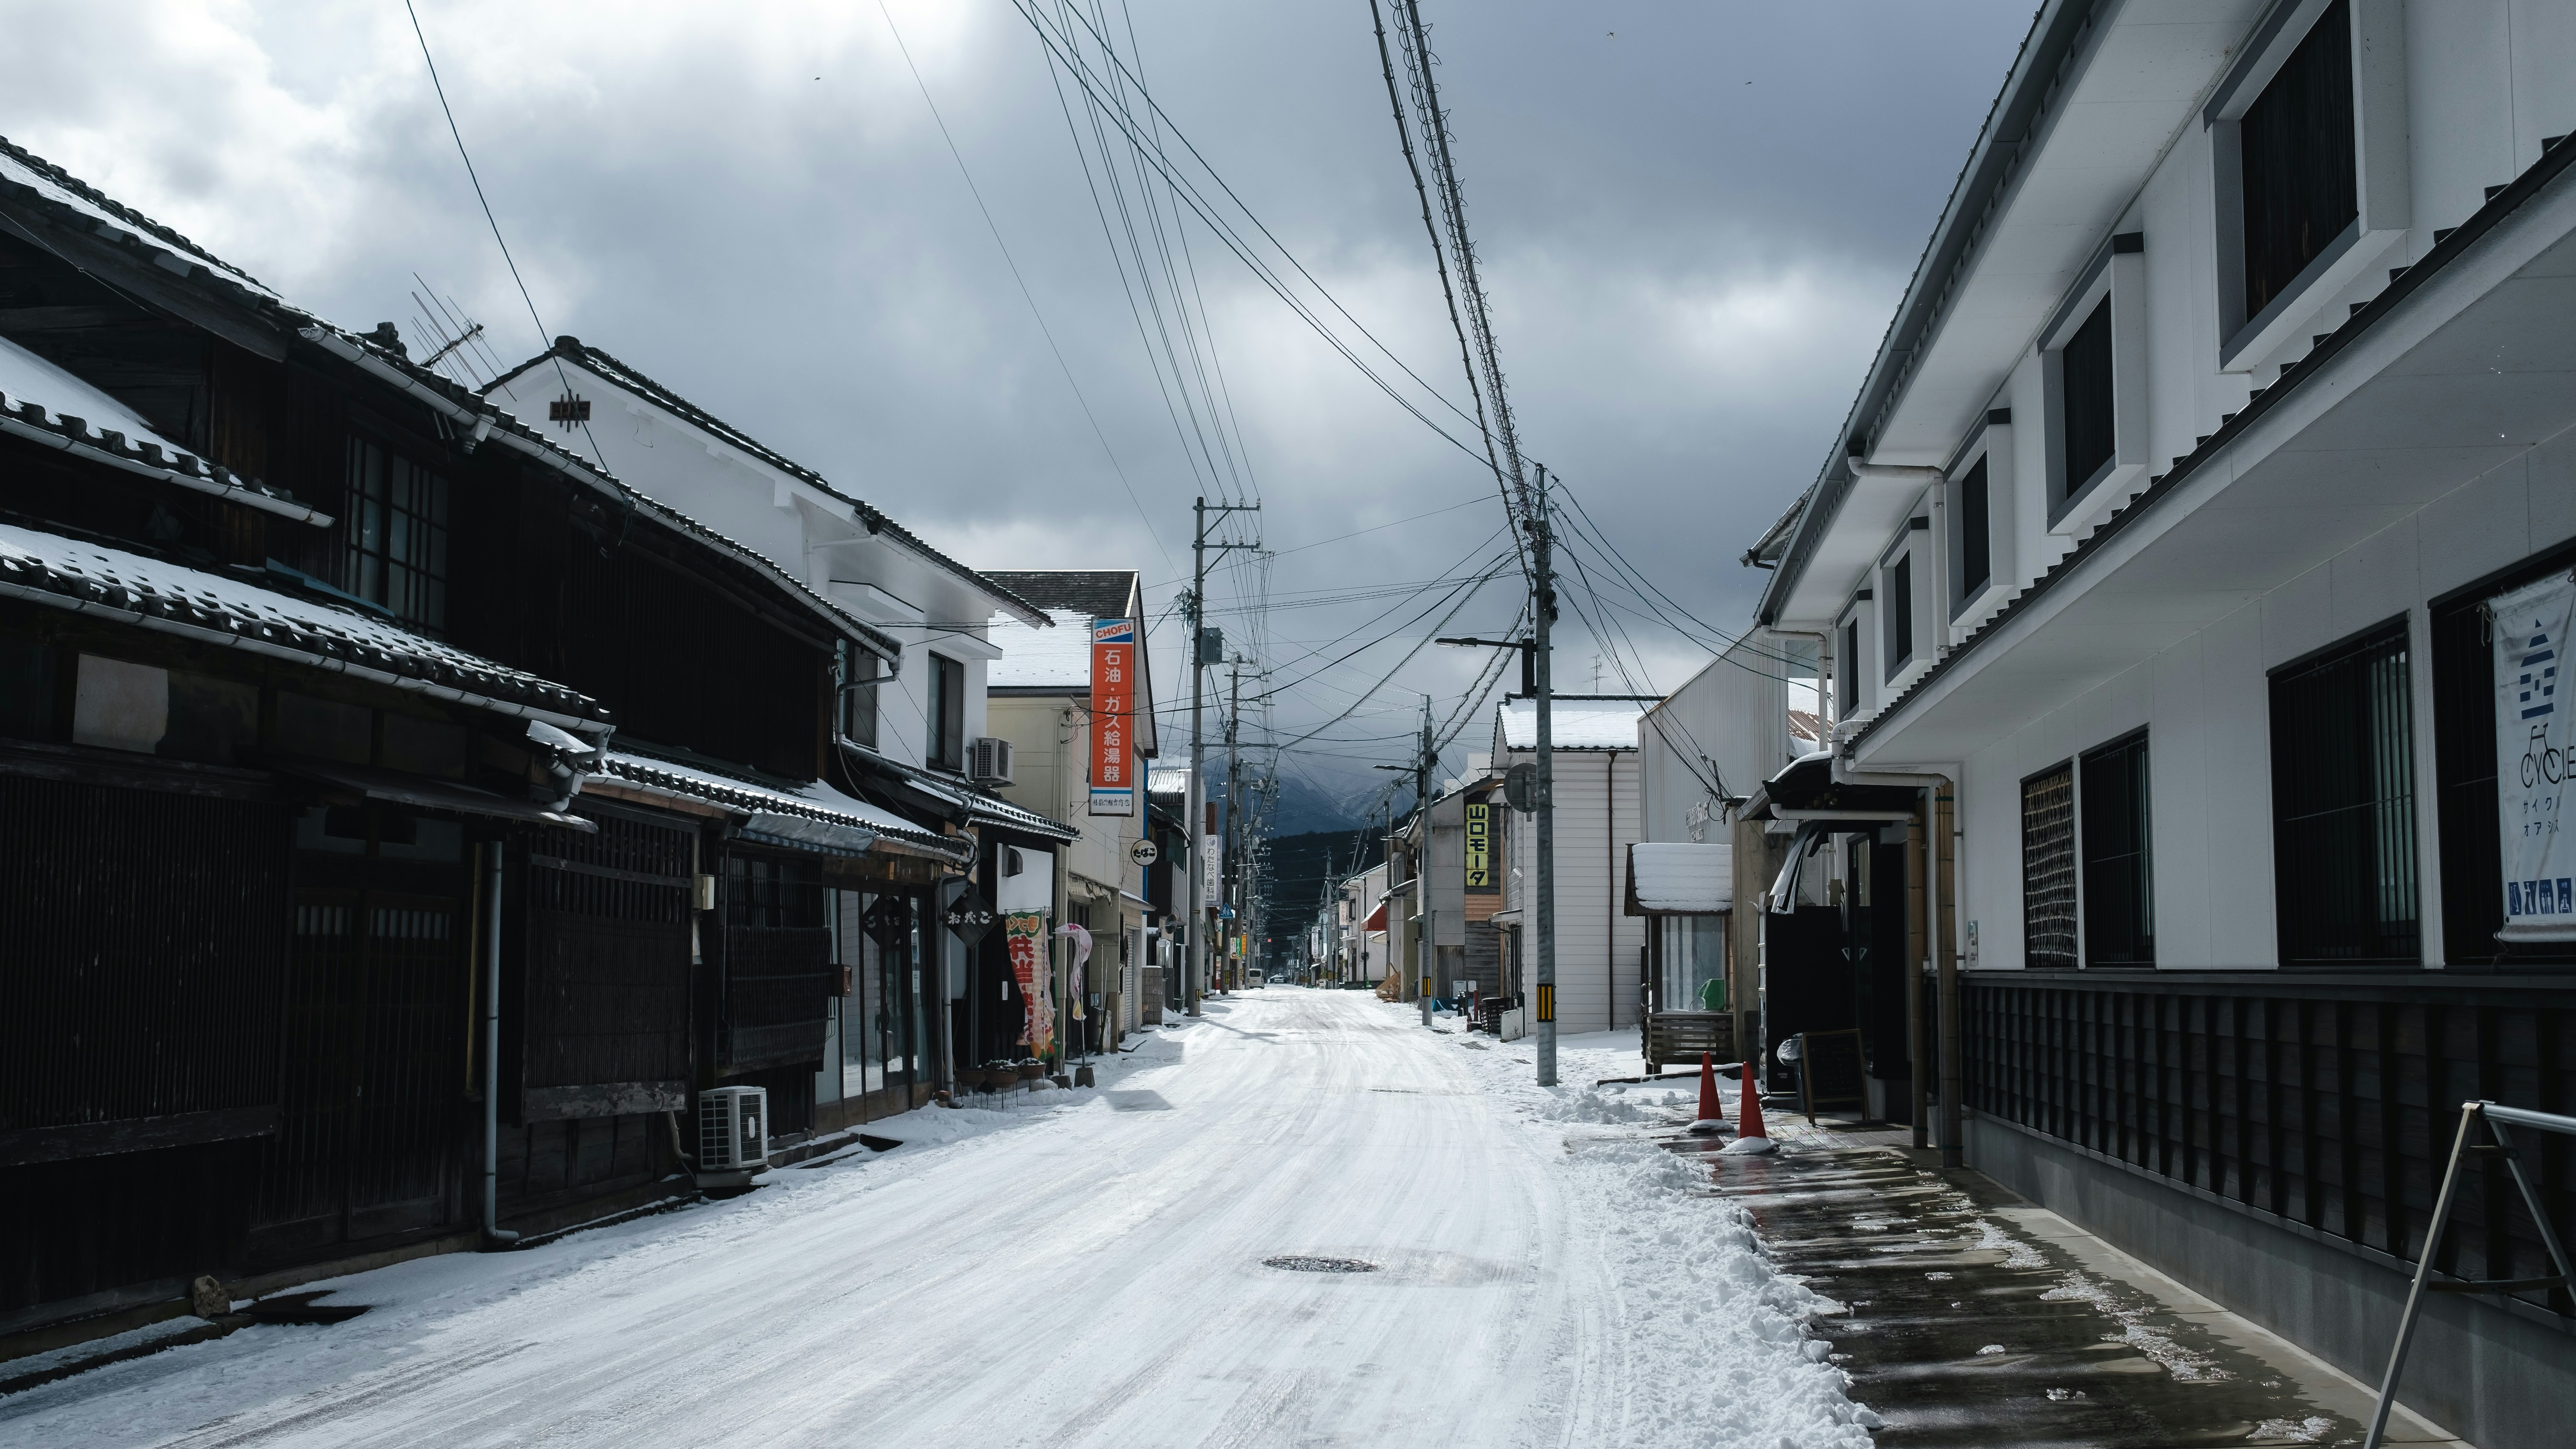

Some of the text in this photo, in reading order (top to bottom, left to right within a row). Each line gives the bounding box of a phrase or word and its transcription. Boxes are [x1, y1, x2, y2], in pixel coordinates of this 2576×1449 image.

[1096, 623, 1131, 638] CHOFU
[1103, 649, 1121, 782] 石油・ガス給湯器
[2520, 746, 2576, 789] CYCLE
[2524, 819, 2559, 837] オアシス
[1133, 847, 1155, 858] たばこ
[1469, 805, 1486, 886] 山口モータ
